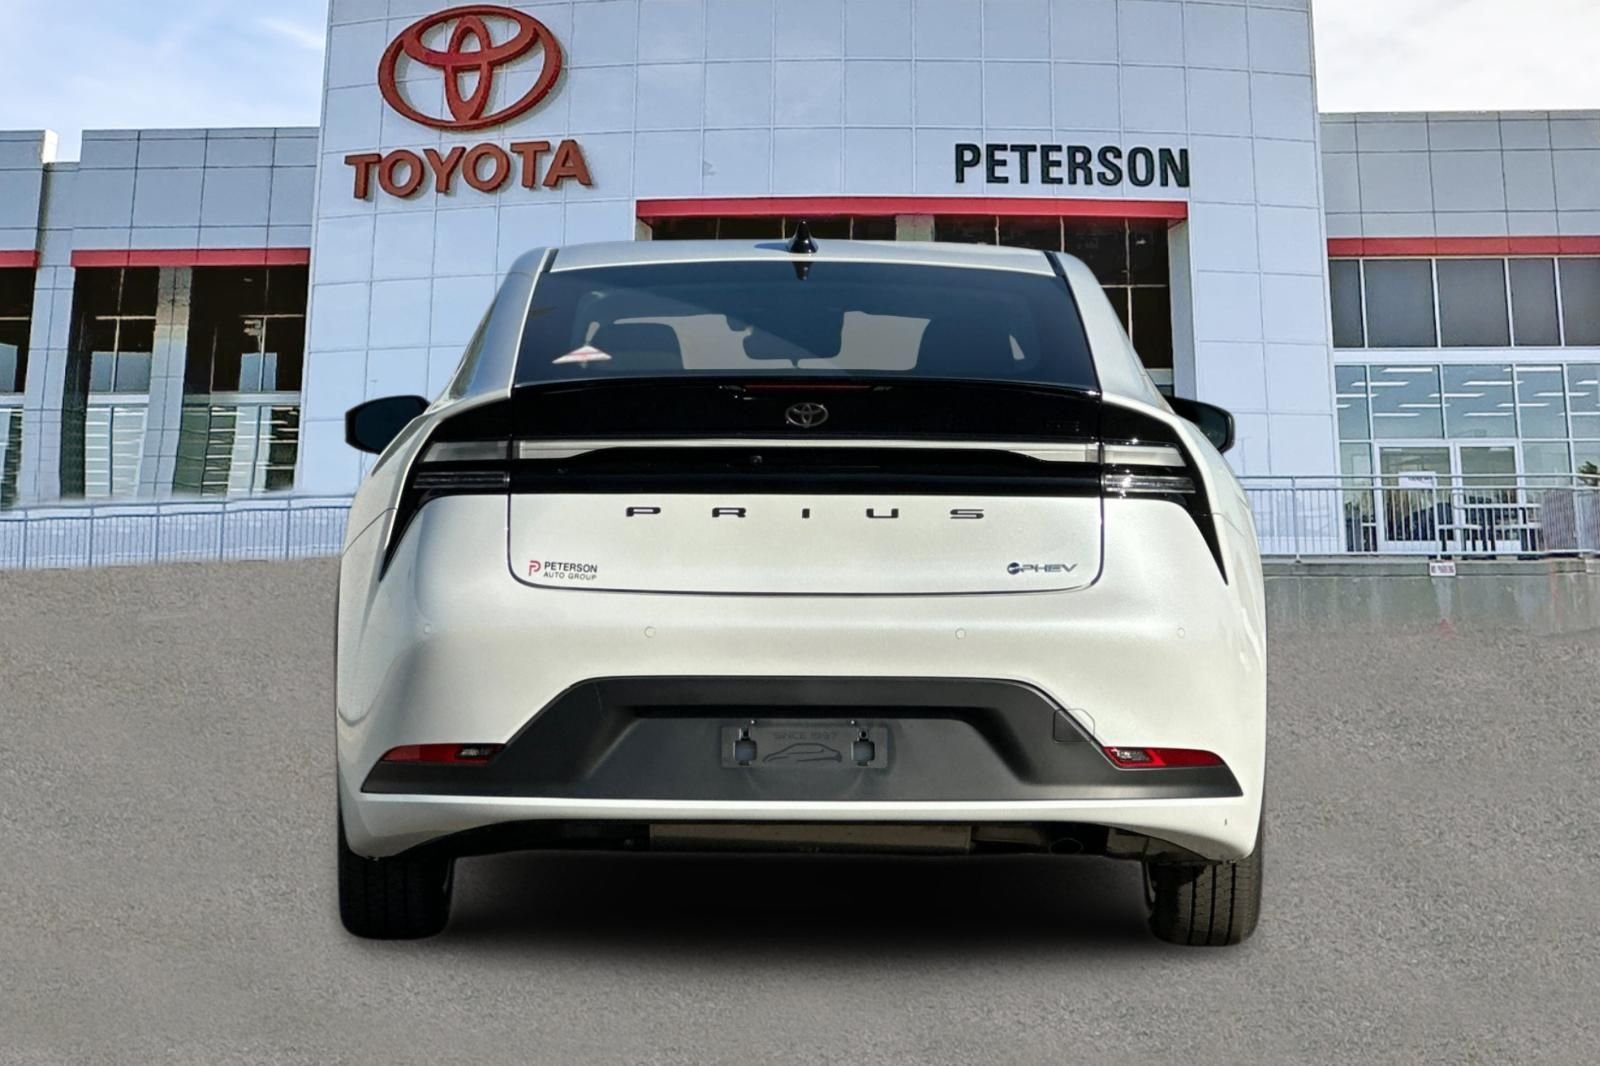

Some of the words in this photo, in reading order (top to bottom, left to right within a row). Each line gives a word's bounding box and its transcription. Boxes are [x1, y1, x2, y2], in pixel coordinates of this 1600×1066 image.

[344, 139, 592, 200] TOYOTA
[954, 143, 1191, 188] PETERSON
[625, 506, 985, 519] PRIUS
[544, 561, 598, 573] PETERSON
[1020, 563, 1078, 573] PHEV
[567, 572, 597, 580] GROUP
